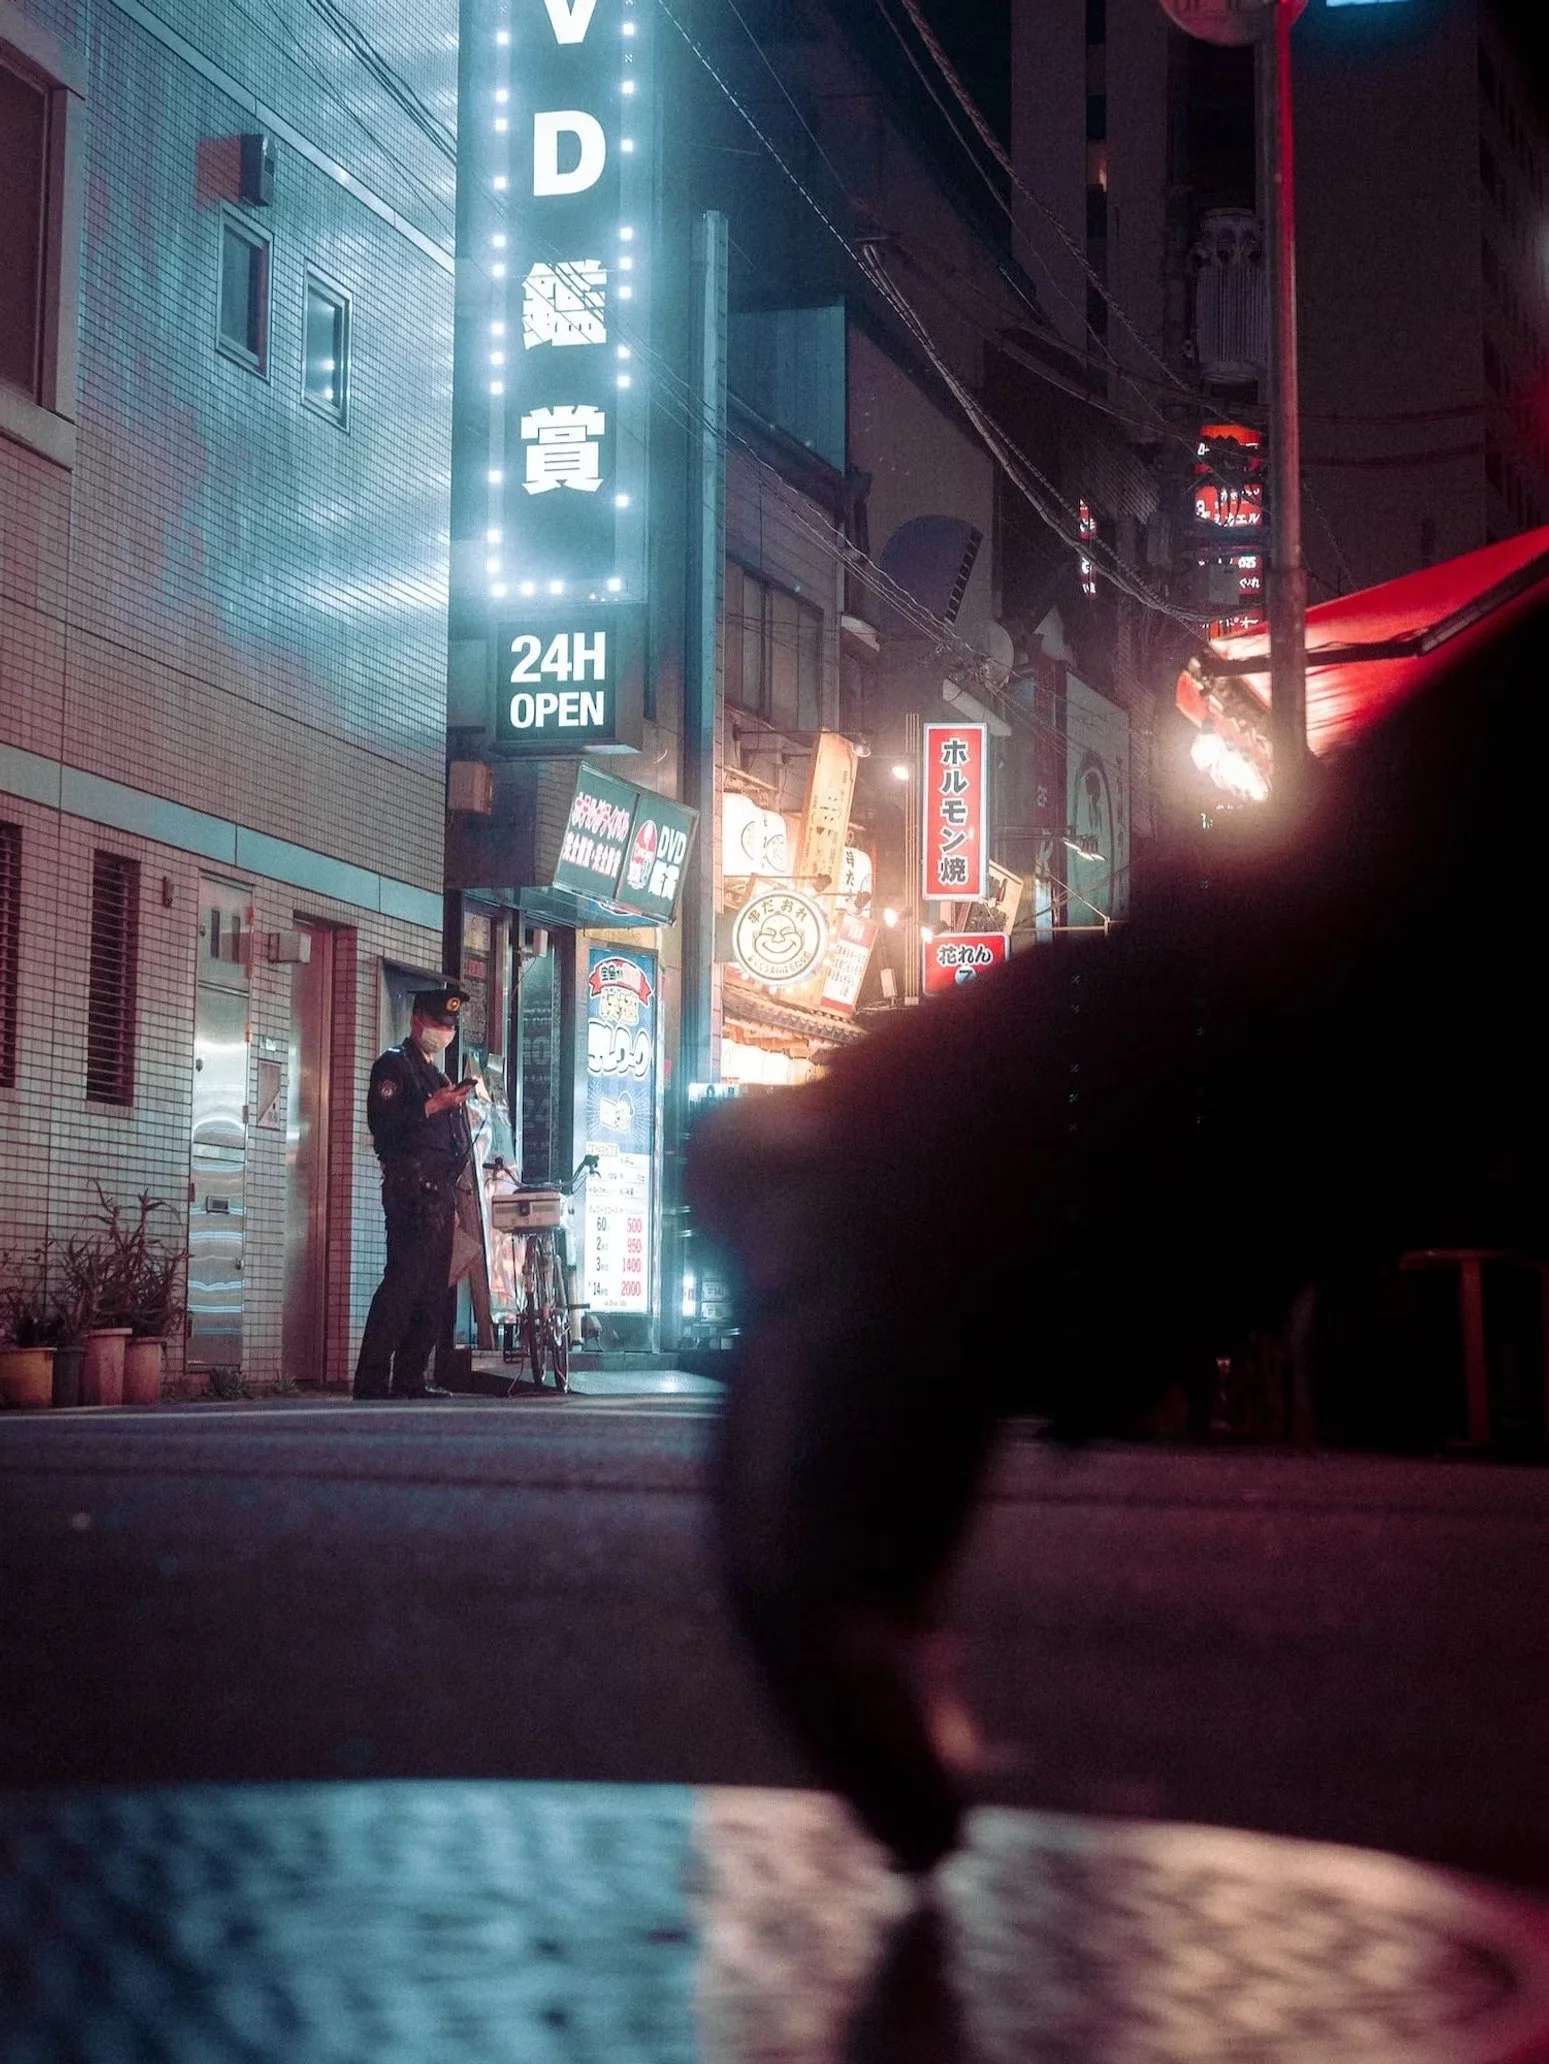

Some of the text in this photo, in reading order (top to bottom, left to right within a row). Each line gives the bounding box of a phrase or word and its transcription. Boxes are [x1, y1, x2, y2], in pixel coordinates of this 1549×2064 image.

[511, 632, 606, 683] 24H
[510, 691, 605, 729] OPEN
[940, 740, 968, 883] ホルモン焼
[657, 825, 687, 865] DVD
[748, 899, 807, 924] 串だおれ
[938, 945, 992, 965] 花れん
